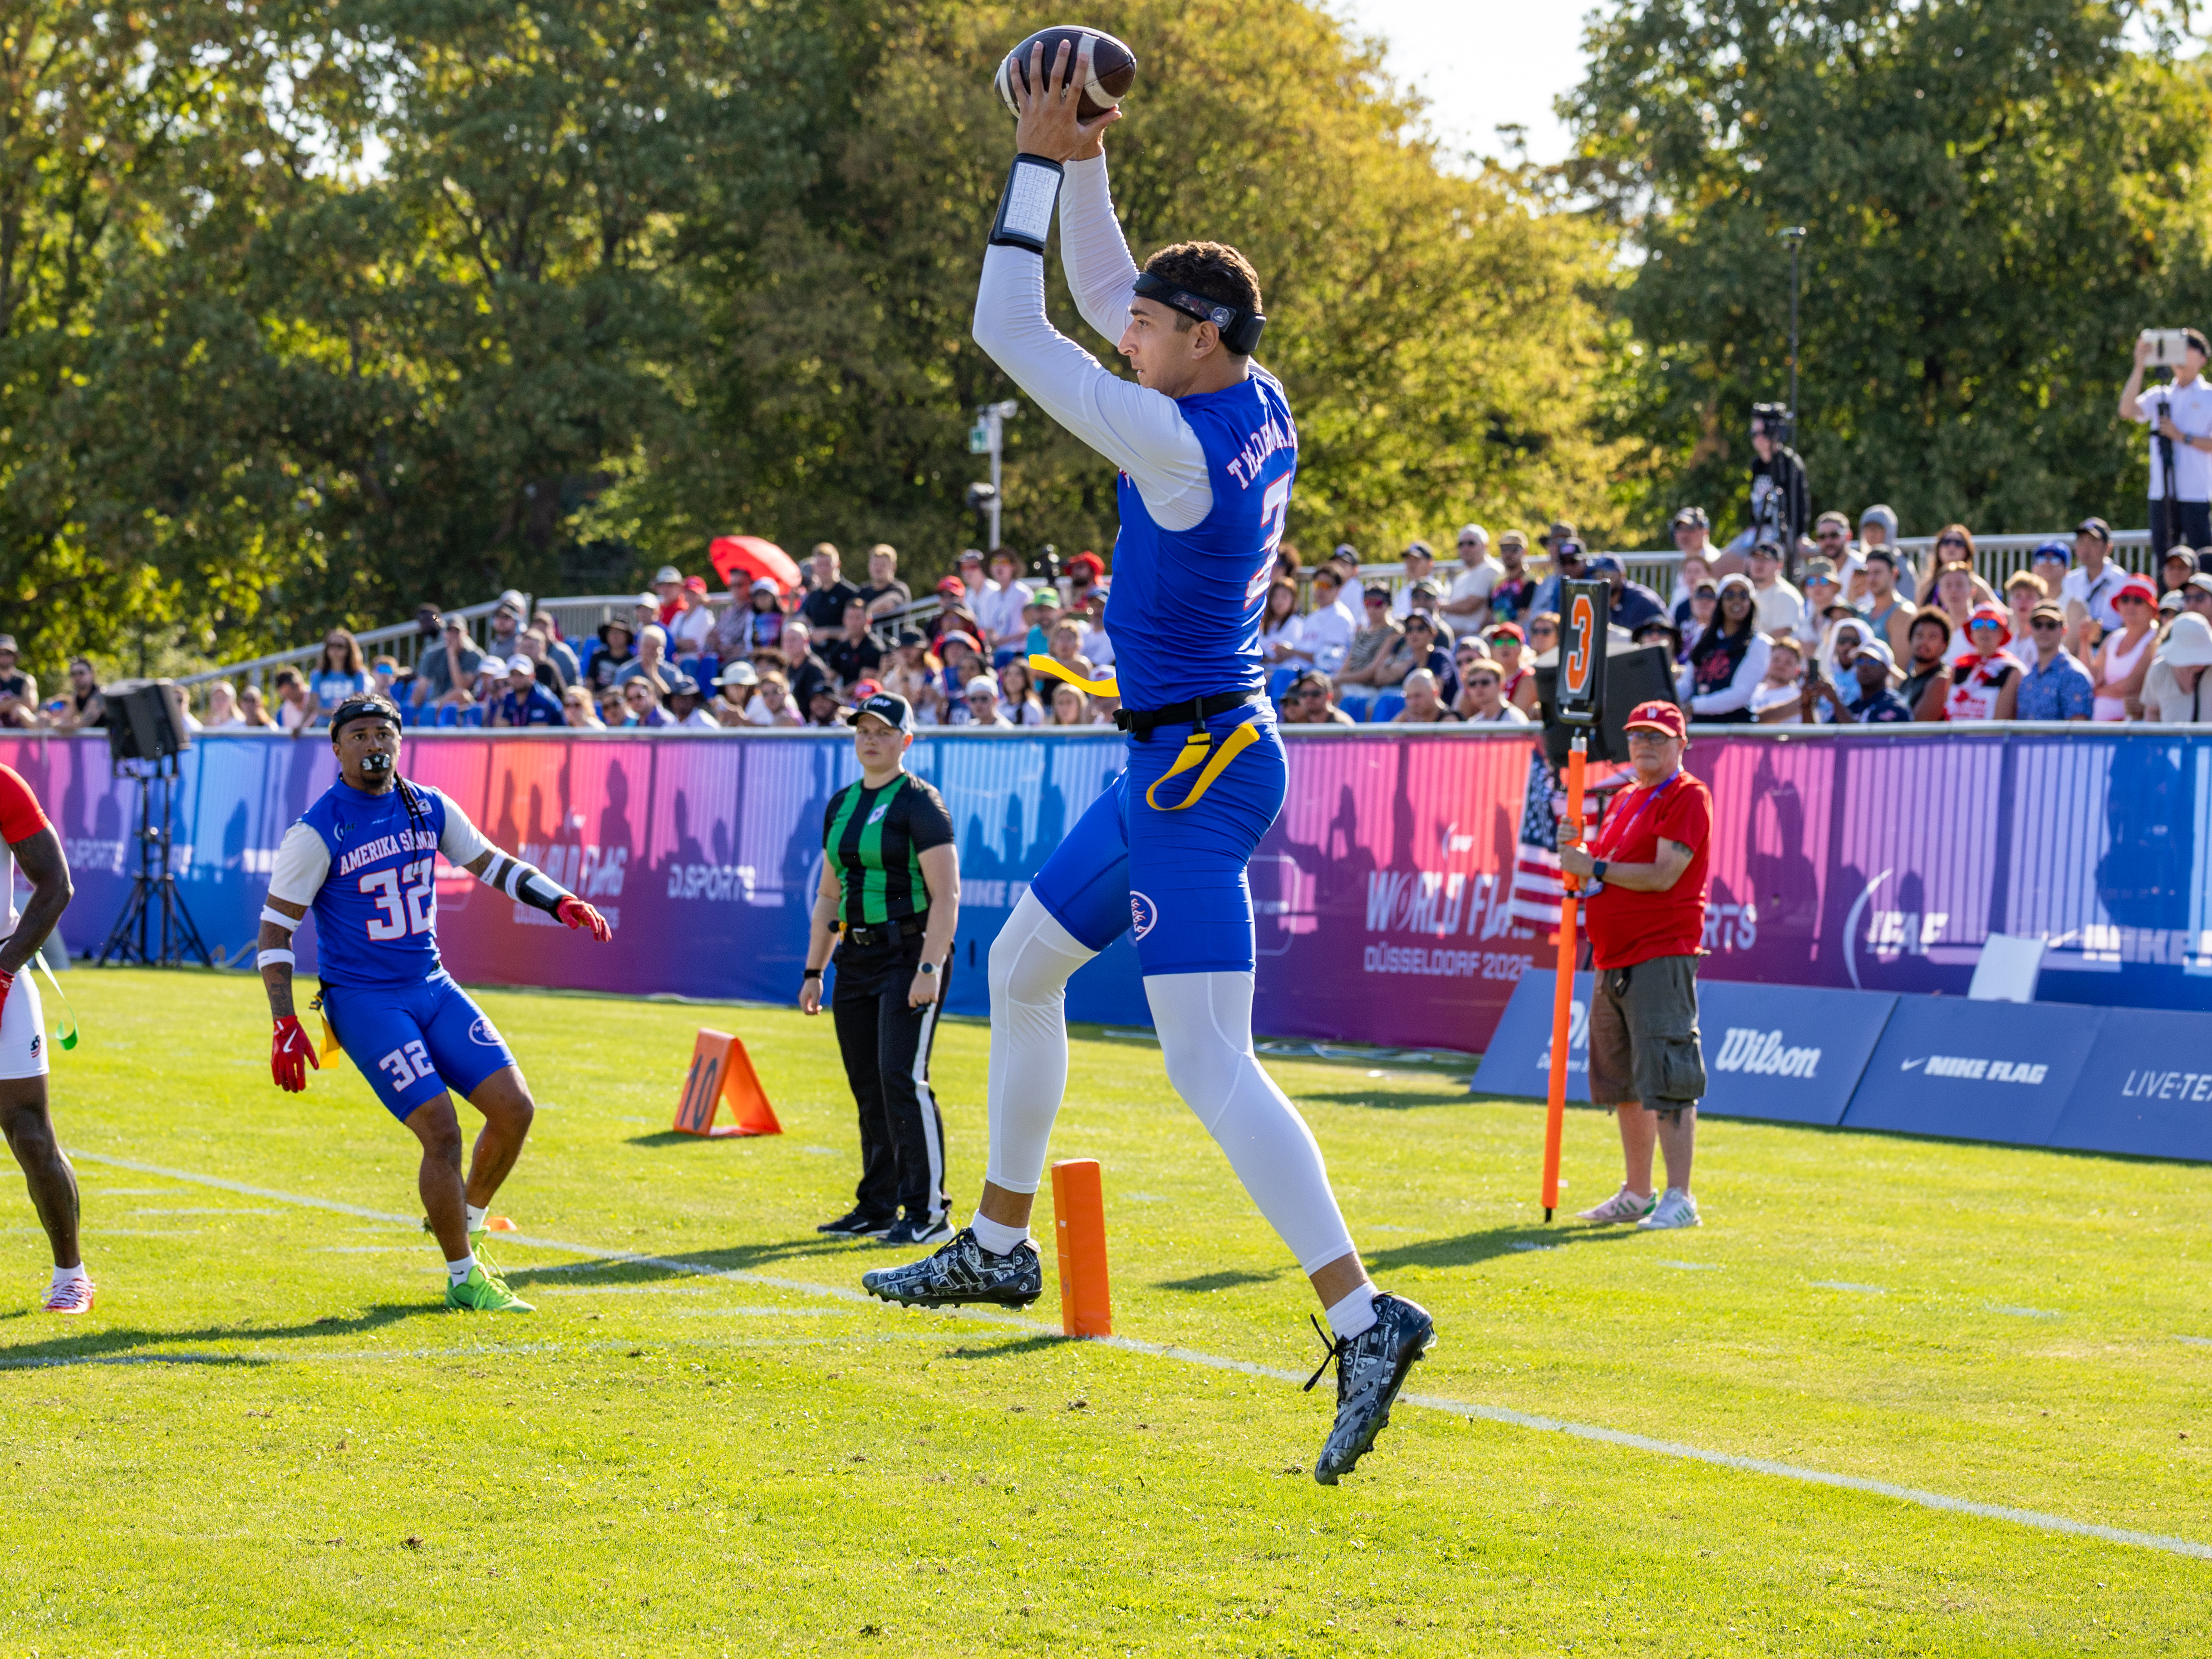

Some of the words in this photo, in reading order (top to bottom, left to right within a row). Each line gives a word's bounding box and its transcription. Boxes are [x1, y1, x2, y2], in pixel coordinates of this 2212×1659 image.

[1565, 594, 1594, 694] 3
[1647, 706, 1659, 719] W
[340, 834, 401, 876] AMERIKA
[358, 857, 436, 941] 32
[1365, 870, 1466, 936] WORLD
[1363, 941, 1481, 977] DÜSSELDORF
[378, 1039, 436, 1092] 32
[1715, 1027, 1822, 1079] Wilson
[1923, 1055, 1990, 1080] NIKE
[1985, 1060, 2049, 1085] FLAG
[679, 1054, 718, 1131] 10
